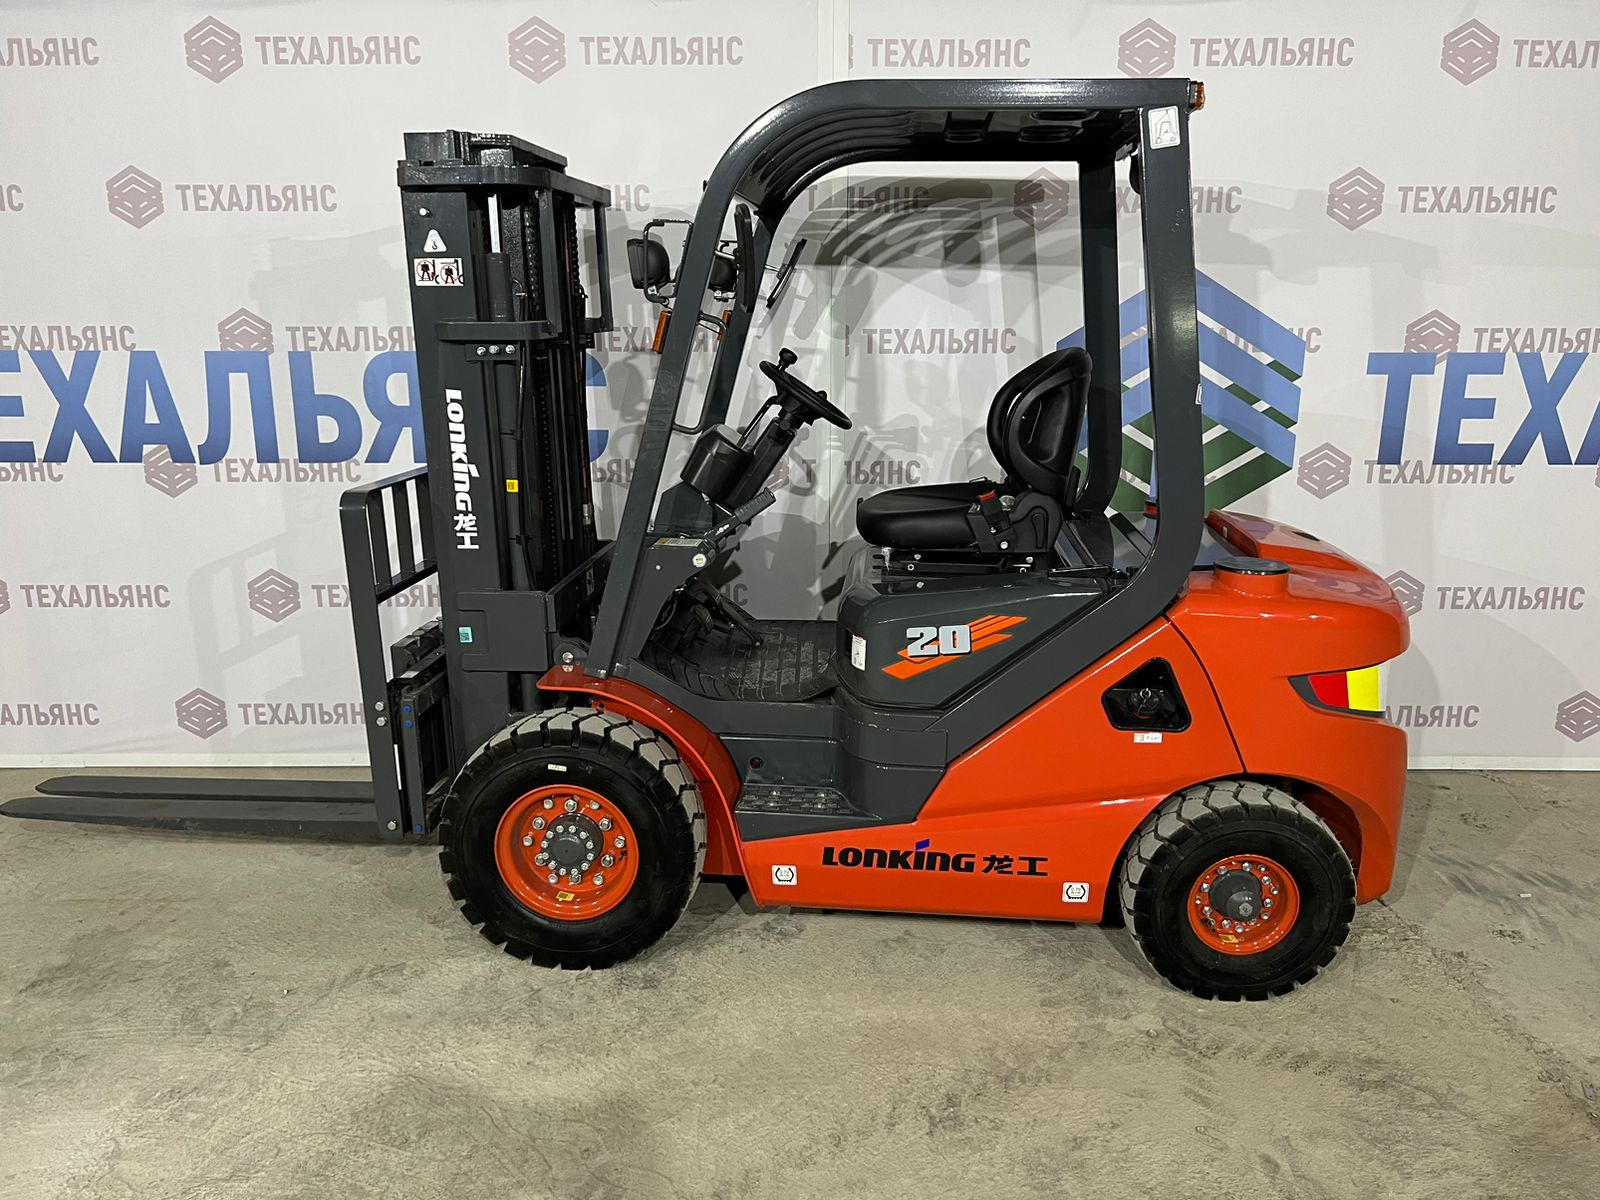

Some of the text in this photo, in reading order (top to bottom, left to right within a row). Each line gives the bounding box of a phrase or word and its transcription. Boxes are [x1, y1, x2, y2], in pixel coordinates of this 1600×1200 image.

[255, 36, 421, 65] ТЕХАЛЬЯНС
[580, 36, 743, 65] ТЕХАЛЬЯНС
[868, 38, 1031, 68] ТЕХАЛЬЯНС
[1190, 37, 1355, 67] ТЕХАЛЬЯНС
[1513, 40, 1600, 68] ТЕХАЛ
[175, 184, 337, 212] ТЕХАЛЬЯНС
[1398, 186, 1557, 214] ТЕХАЛЬЯНС
[863, 328, 1017, 354] ТЕХАЛЬЯНС
[20, 584, 170, 608] ТЕХАЛЬЯНС
[1437, 587, 1586, 610] ТЕХАЛЬЯНС
[906, 625, 971, 658] 20
[0, 703, 100, 726] АЛЬЯНС
[237, 703, 366, 725] ТЕХАЛЬЯН
[982, 855, 1048, 876] 龙工
